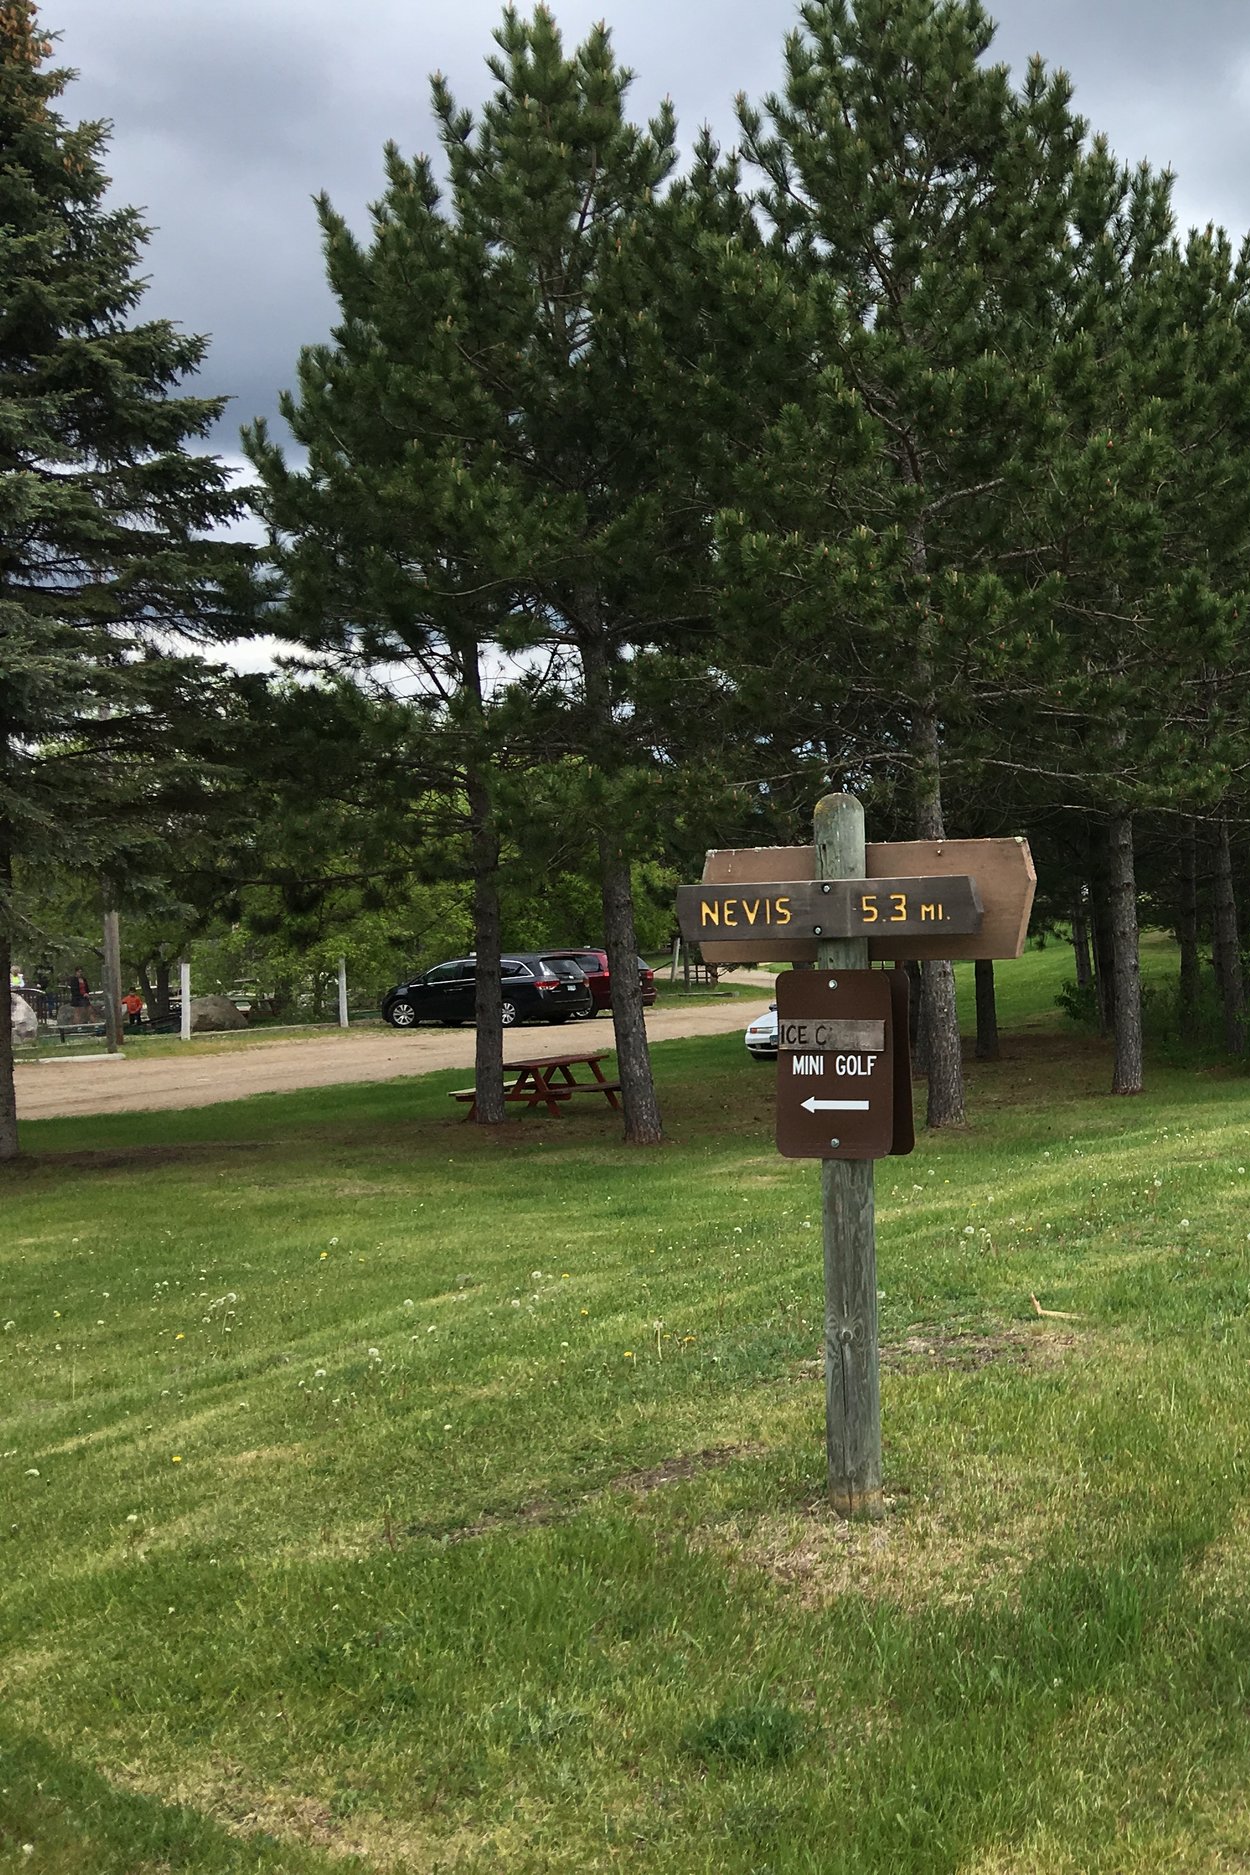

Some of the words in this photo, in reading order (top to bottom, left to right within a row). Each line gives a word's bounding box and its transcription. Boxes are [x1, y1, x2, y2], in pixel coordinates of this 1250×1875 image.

[701, 897, 792, 926] NEVIS
[861, 894, 907, 922] 5.3
[920, 903, 951, 921] MI.
[780, 1024, 808, 1045] ICE
[792, 1055, 824, 1076] MINI
[835, 1055, 878, 1076] GOLF
